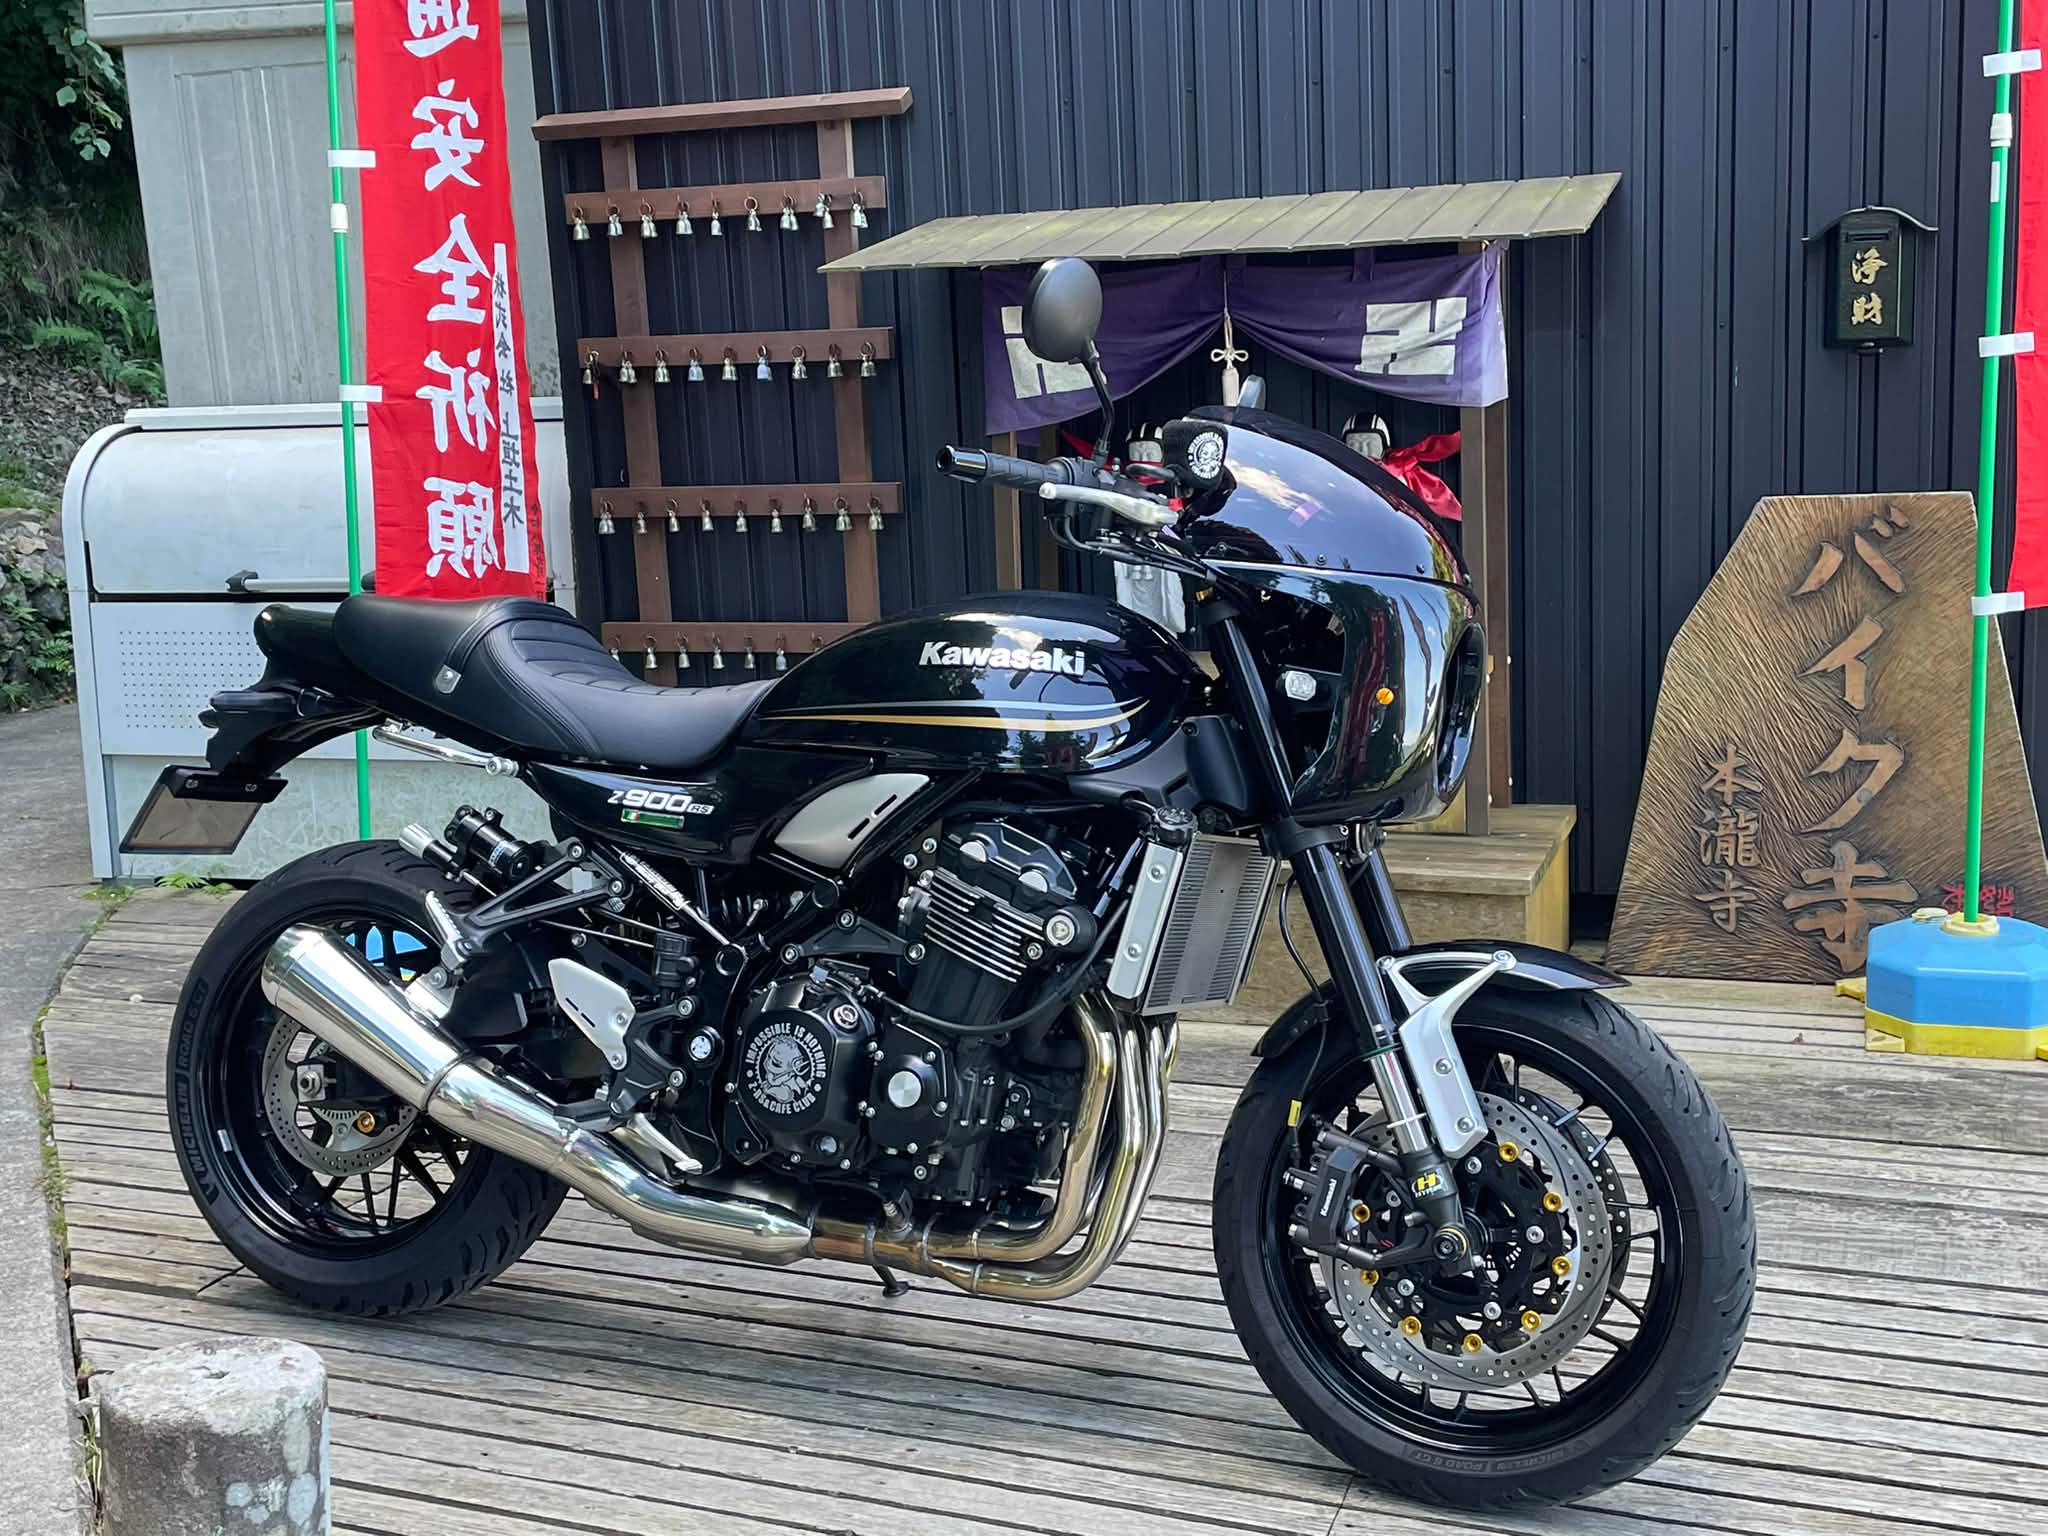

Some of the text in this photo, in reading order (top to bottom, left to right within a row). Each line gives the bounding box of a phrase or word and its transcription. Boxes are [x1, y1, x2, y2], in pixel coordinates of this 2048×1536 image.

[919, 641, 1085, 677] Kawasaki
[1784, 503, 1919, 973] バイク寺
[1695, 743, 1763, 933] 本瀧寺
[745, 1022, 826, 1079] IMPOSSIBLE IS NOTHING
[793, 1092, 816, 1113] CLUB
